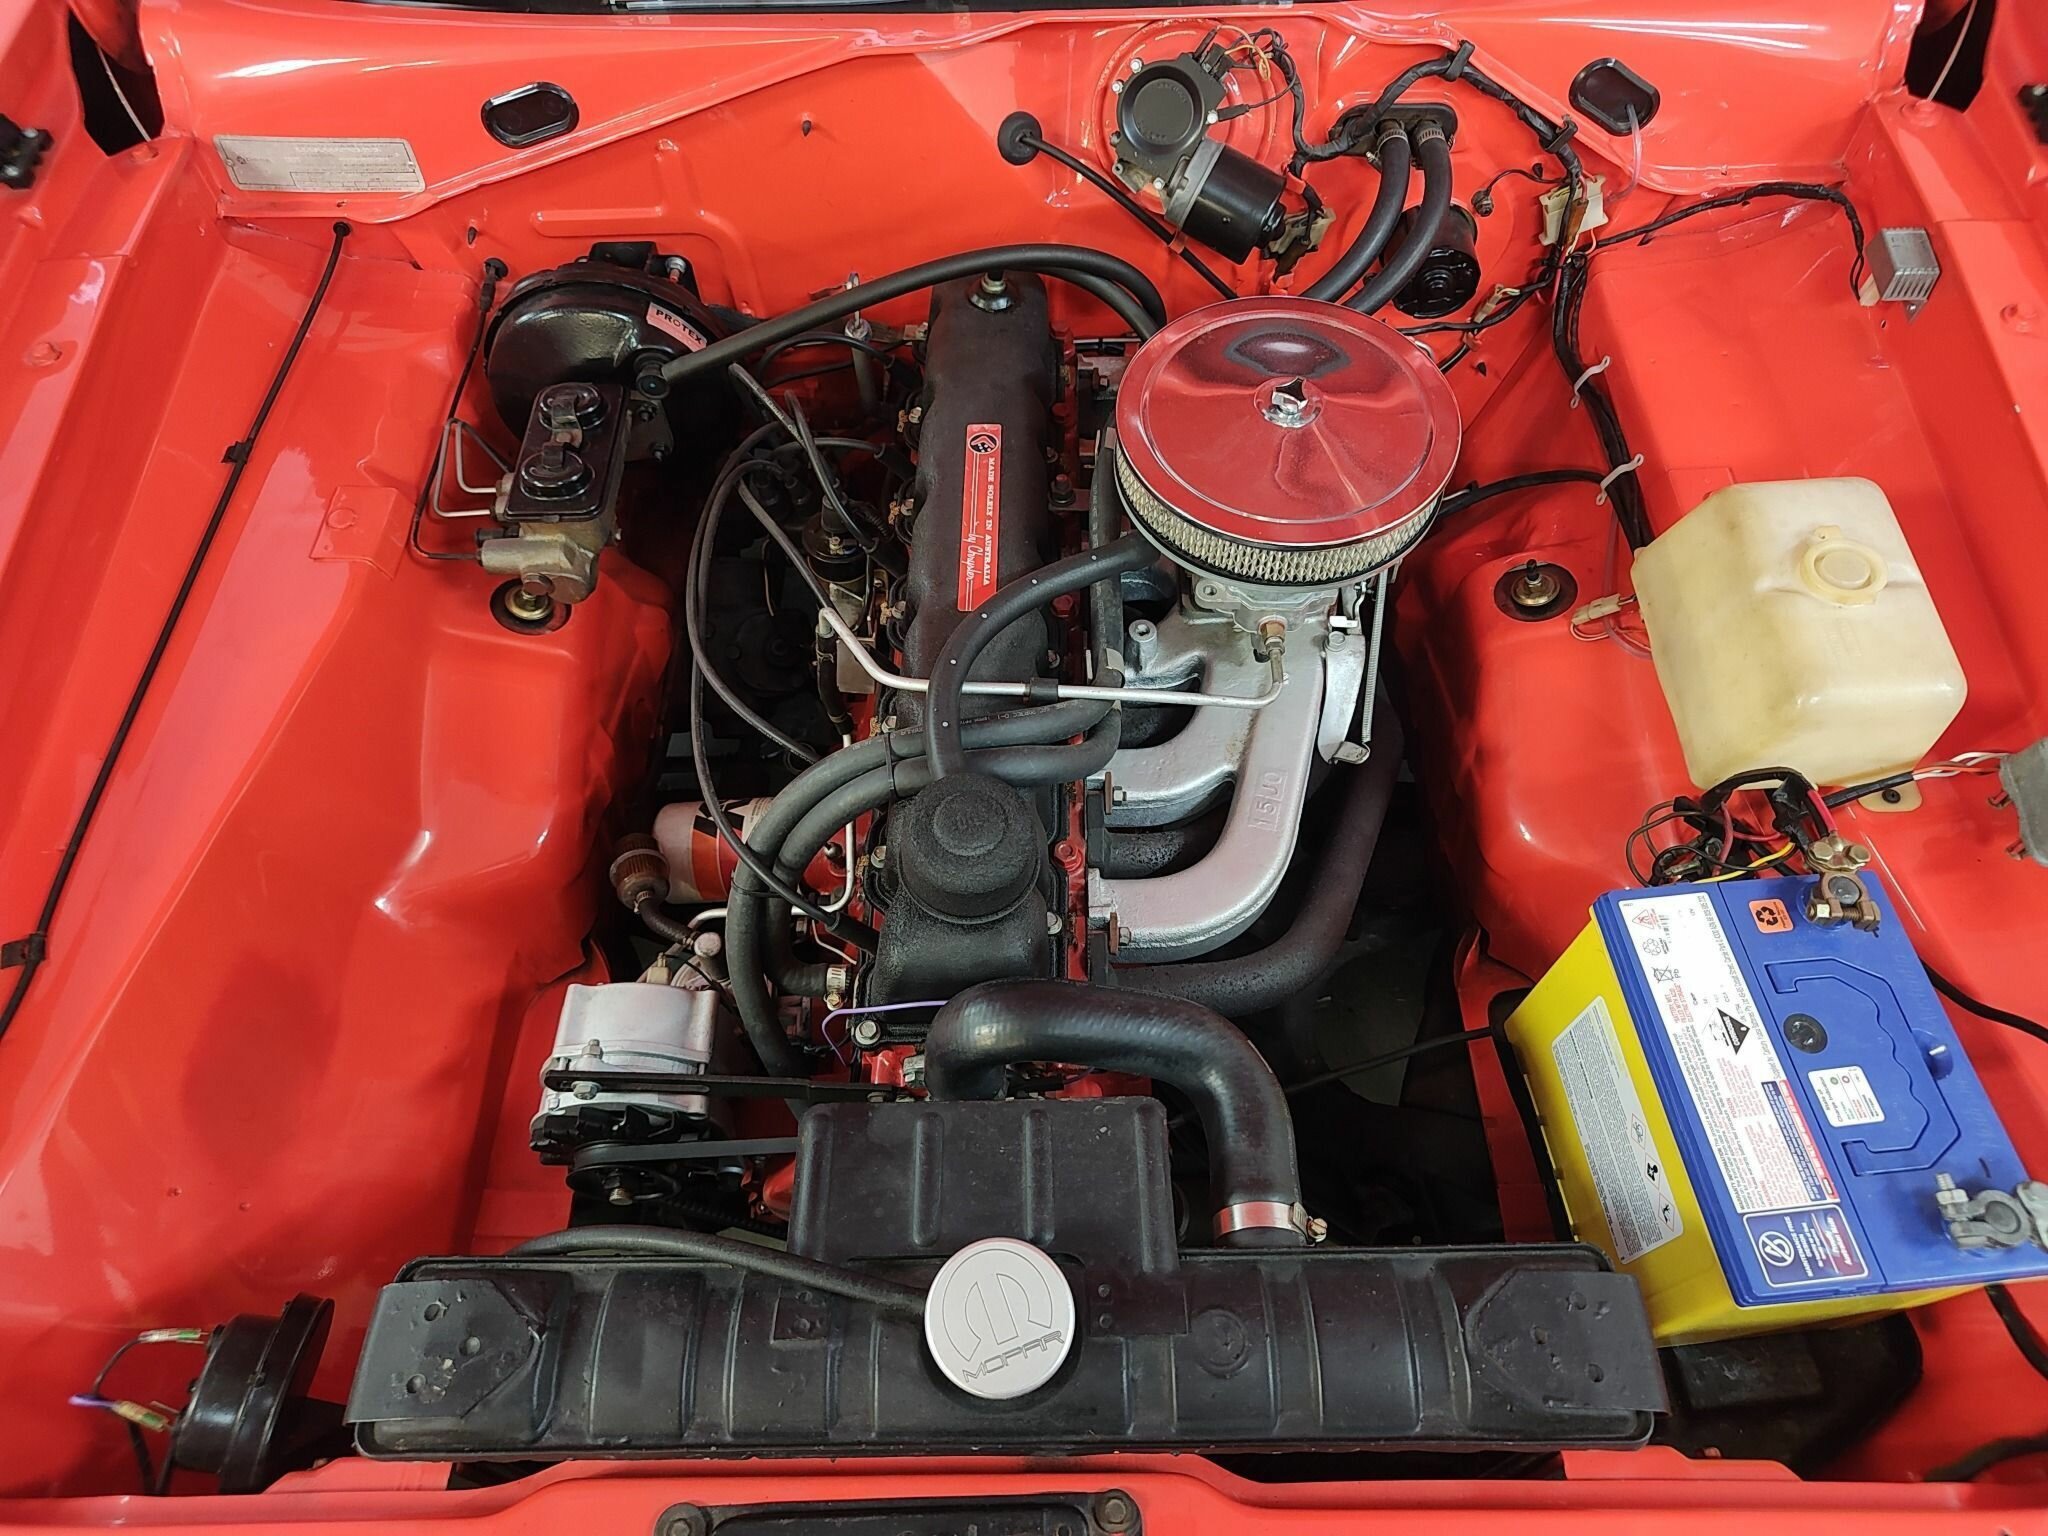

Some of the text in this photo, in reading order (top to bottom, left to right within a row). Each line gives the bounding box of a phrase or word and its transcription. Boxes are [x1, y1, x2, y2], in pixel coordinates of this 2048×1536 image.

[656, 309, 702, 345] PROTEX
[983, 457, 996, 585] MADE SOLELY IN AUSTRALIA
[962, 533, 984, 582] by Chrysler
[962, 1330, 1065, 1383] MOPAR
